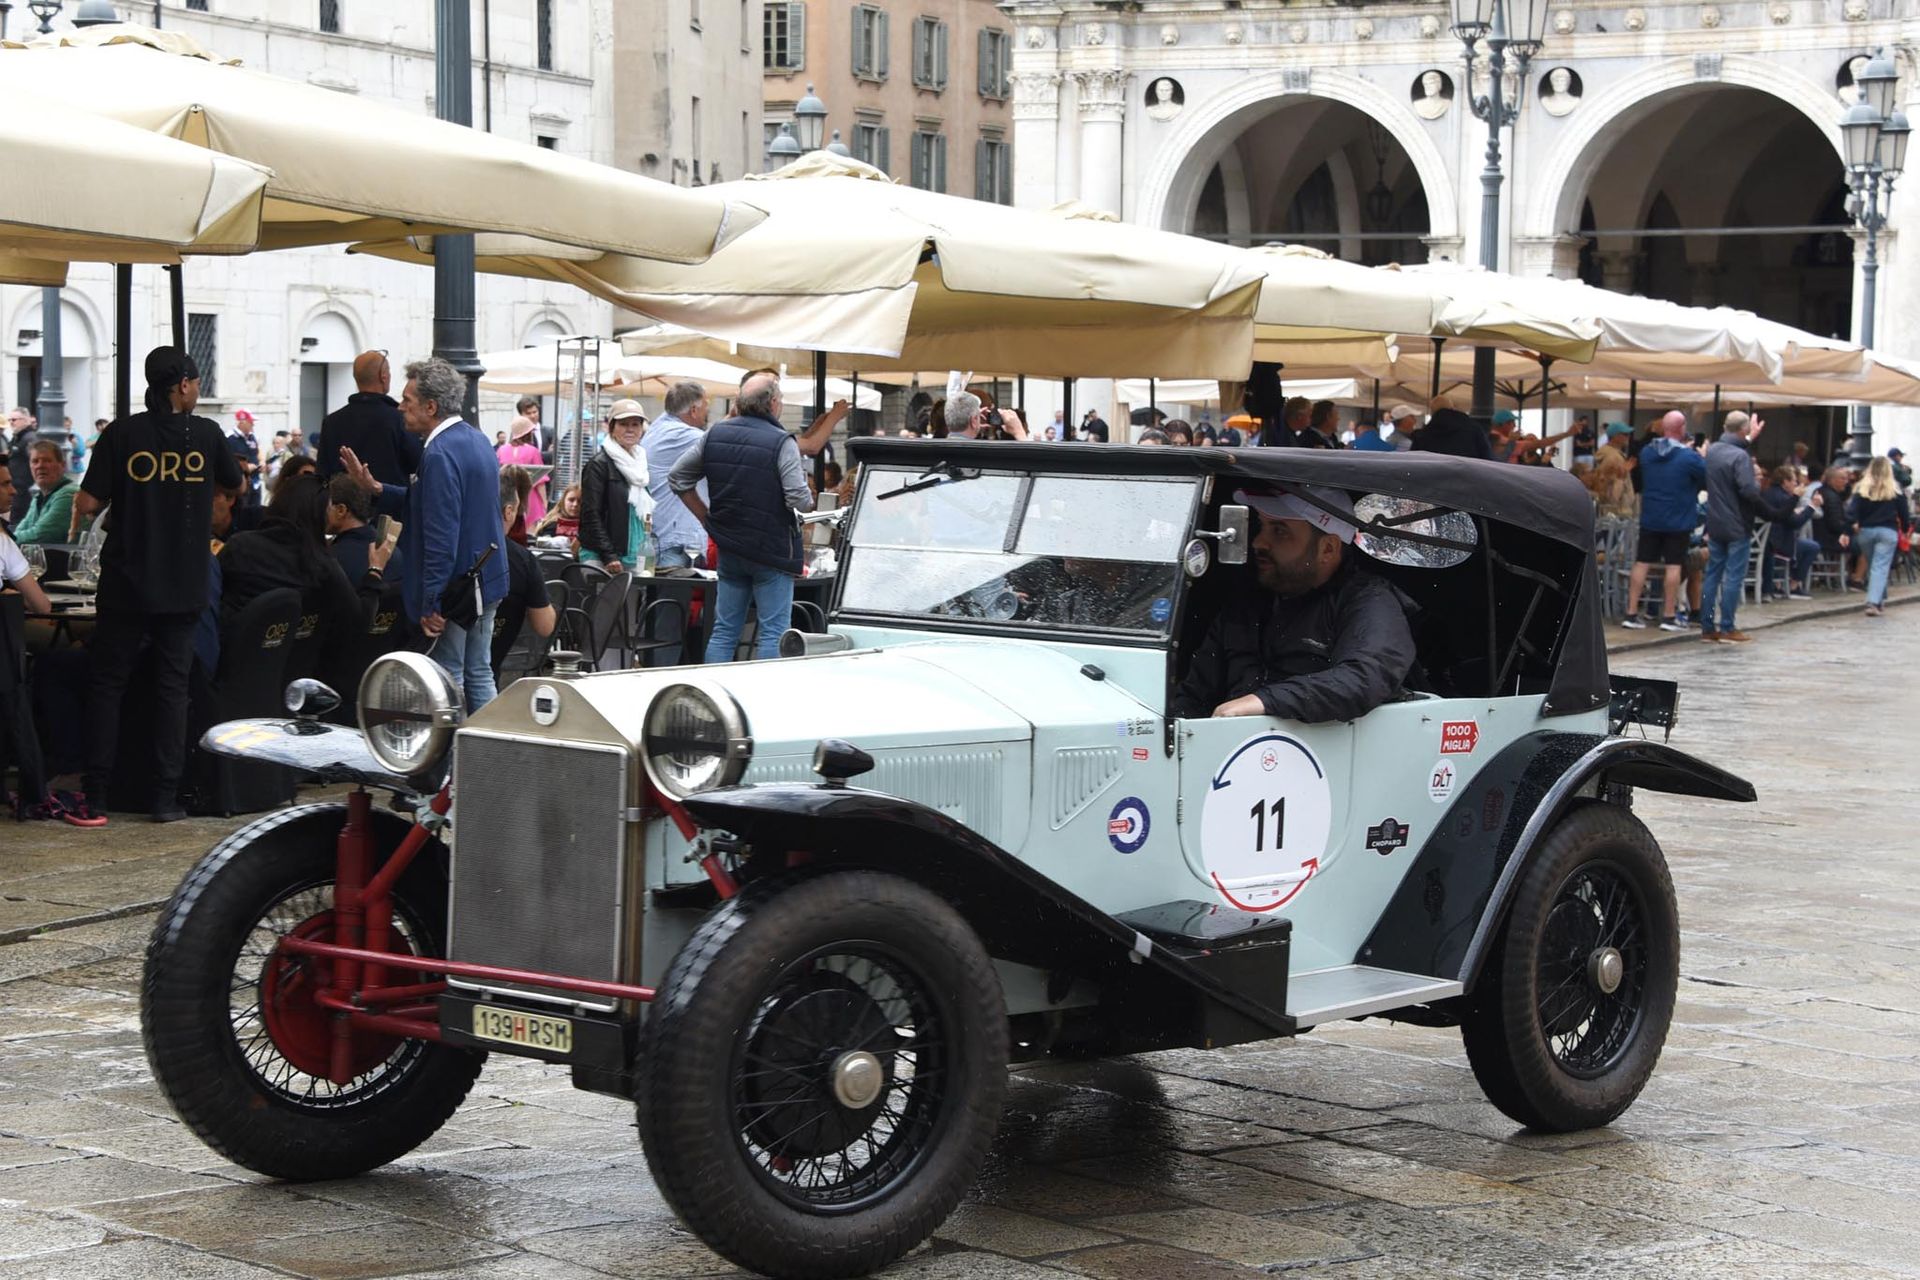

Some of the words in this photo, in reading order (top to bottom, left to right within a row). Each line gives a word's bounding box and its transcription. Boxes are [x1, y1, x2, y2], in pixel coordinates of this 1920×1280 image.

[1319, 513, 1330, 527] 11
[1446, 725, 1471, 736] 1000
[1442, 740, 1471, 751] MIGLIA
[1432, 772, 1453, 788] DLT
[1250, 796, 1285, 852] 11
[1371, 839, 1402, 847] CHOPARD
[480, 1011, 567, 1049] 139HRSM
